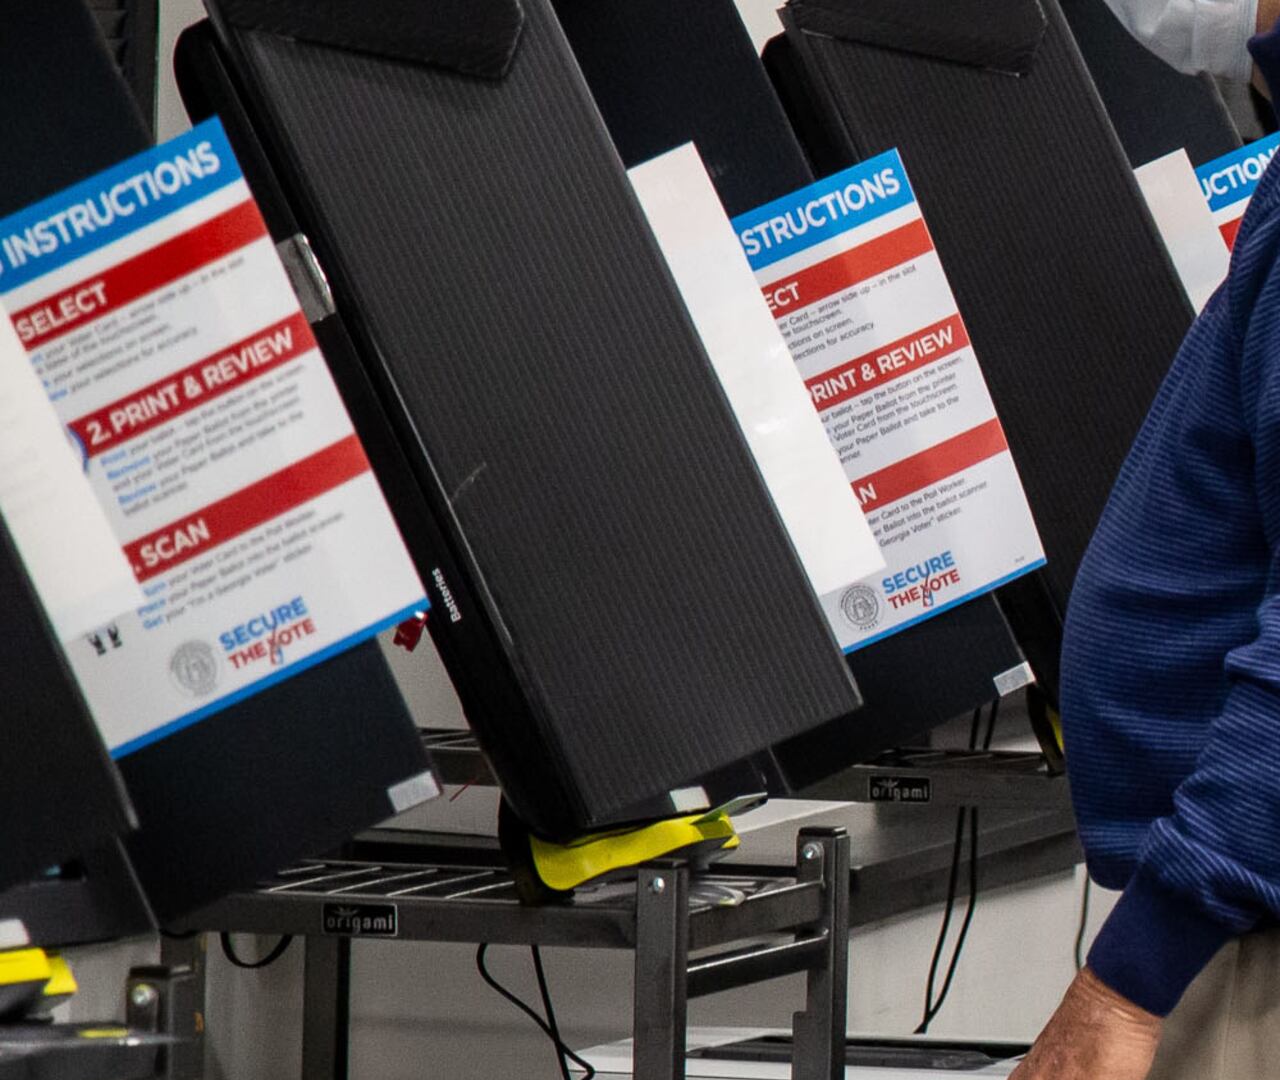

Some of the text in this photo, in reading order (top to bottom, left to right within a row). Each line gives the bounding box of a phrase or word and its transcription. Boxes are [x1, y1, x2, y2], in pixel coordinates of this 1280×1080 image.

[2, 139, 221, 270] INSTRUCTIONS
[739, 166, 900, 258] STRUCTIONS
[14, 280, 110, 344] SELECT
[764, 280, 802, 310] ECT
[85, 325, 296, 446] 2. PRINT & REVIEW
[811, 325, 956, 403] RINT & REVIEW
[139, 517, 210, 569] SCAN
[432, 568, 462, 622] Batteries
[880, 550, 954, 594] SECURE
[888, 585, 920, 610] THE
[219, 596, 307, 652] SECURE
[228, 641, 266, 670] THE
[327, 913, 393, 935] origami
